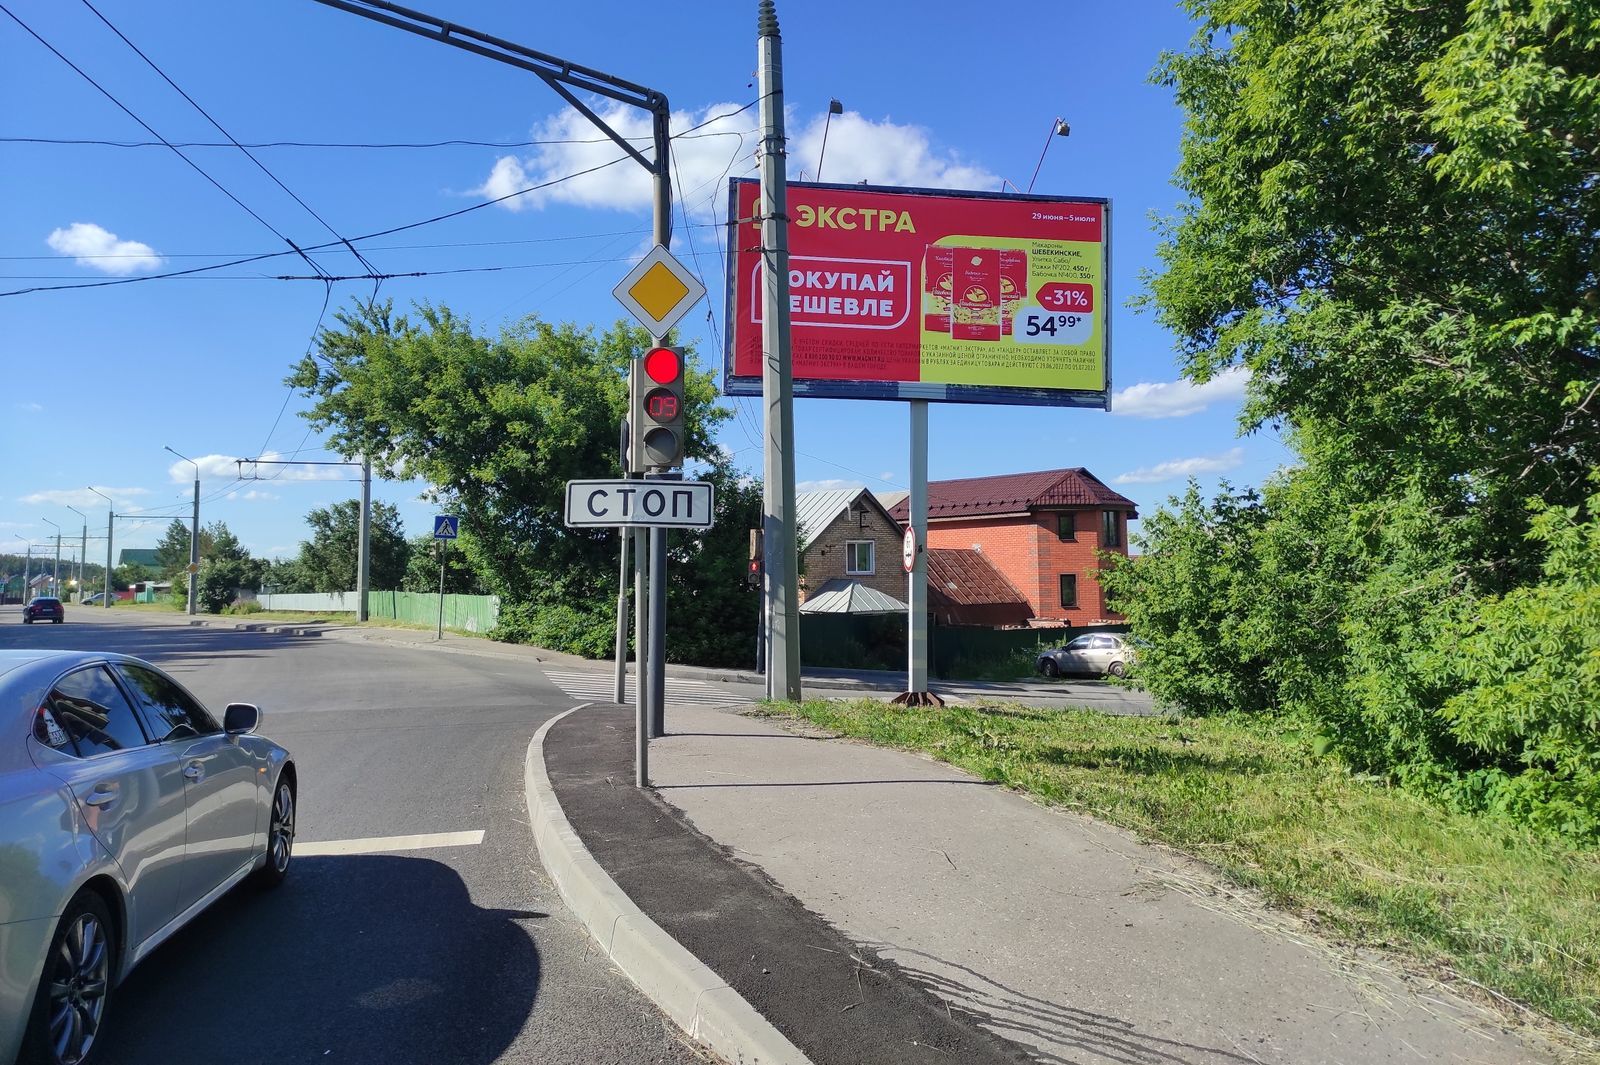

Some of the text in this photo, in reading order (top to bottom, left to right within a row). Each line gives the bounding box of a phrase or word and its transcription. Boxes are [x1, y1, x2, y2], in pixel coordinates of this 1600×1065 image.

[795, 204, 917, 234] ЭКСТРА
[1032, 212, 1042, 220] 29
[1031, 241, 1063, 249] Макароны
[1031, 249, 1082, 258] ШЕБЕКИНСКИЕ,
[789, 269, 894, 293] ОКУПАЙ
[789, 295, 893, 317] ЕШЕВЛЕ
[1044, 289, 1088, 306] -31%
[1026, 315, 1057, 337] 54
[926, 351, 956, 359] УКАЗАННОЙ
[1010, 354, 1046, 362] НЕОБХОДИМО
[1047, 355, 1071, 363] УТОЧНЯТЬ
[1023, 347, 1051, 355] ОСТАВЛЯЕТ
[1061, 348, 1077, 356] СОБОЙ
[587, 488, 693, 518] СТОП
